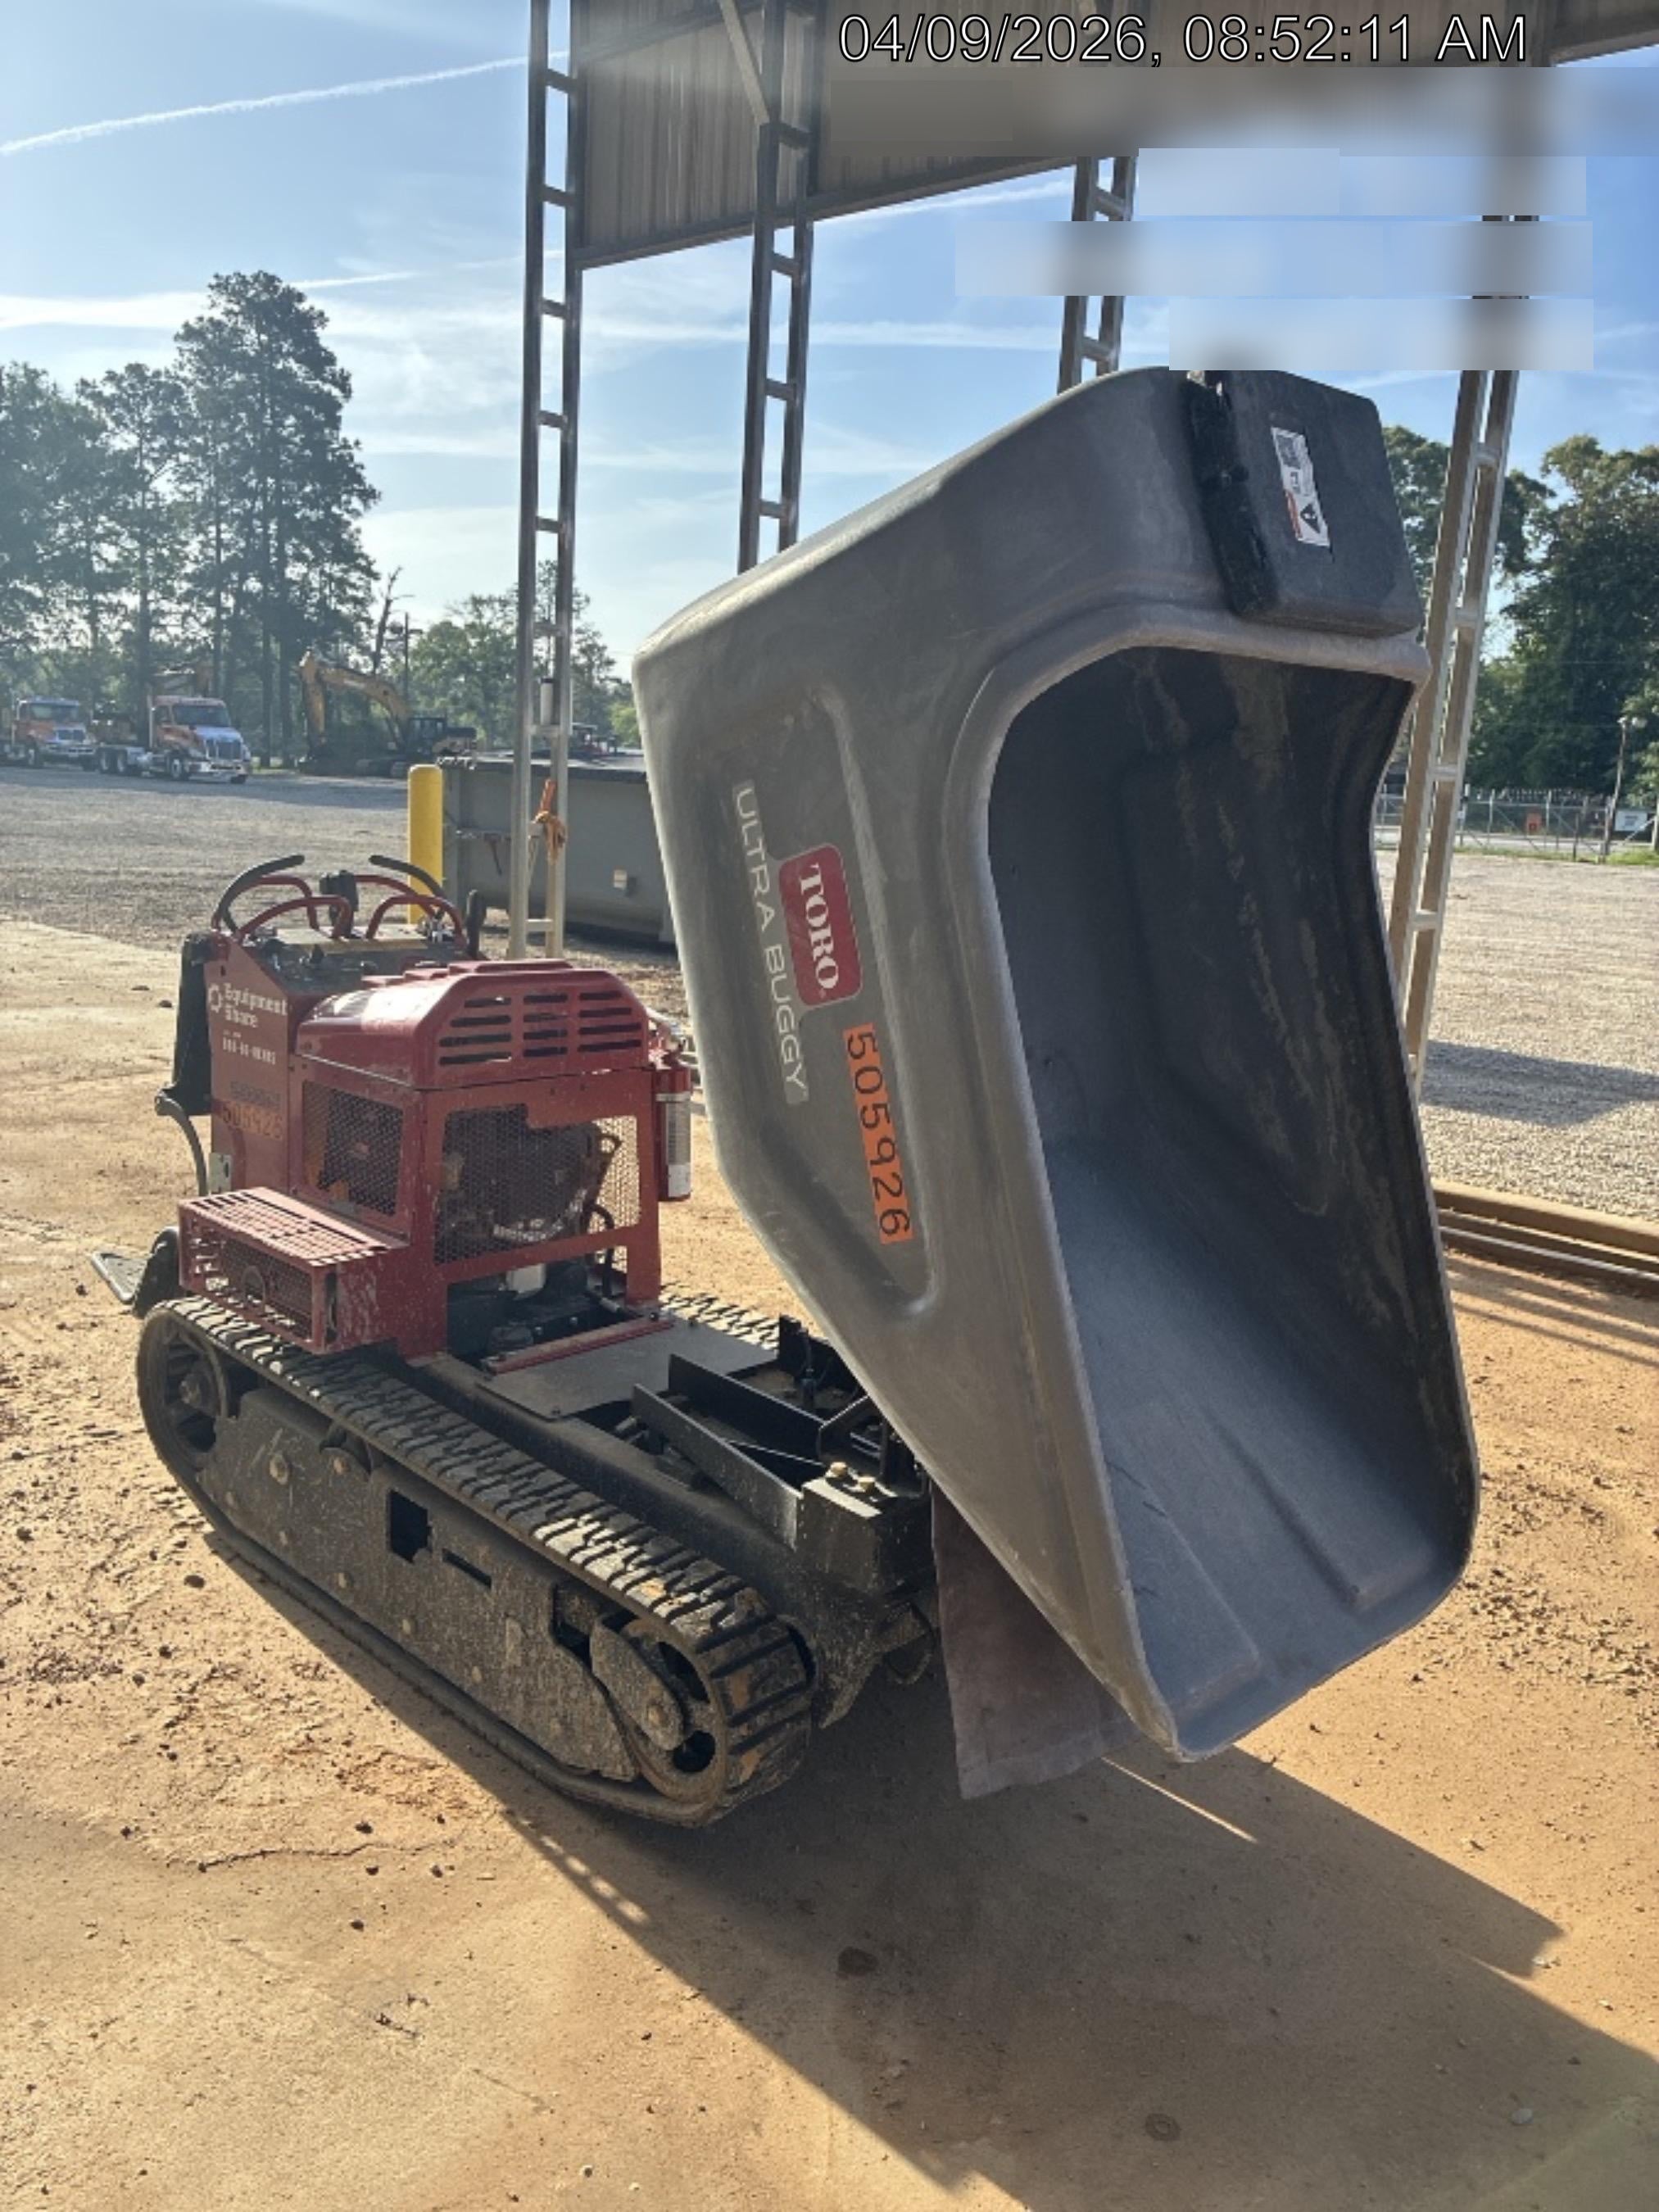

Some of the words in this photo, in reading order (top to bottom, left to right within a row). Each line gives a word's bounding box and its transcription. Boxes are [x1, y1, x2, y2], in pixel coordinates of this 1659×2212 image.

[737, 788, 776, 931] ULTRA
[764, 944, 806, 1091] BUGGY
[799, 862, 839, 990] TORO
[847, 1031, 910, 1235] 505926
